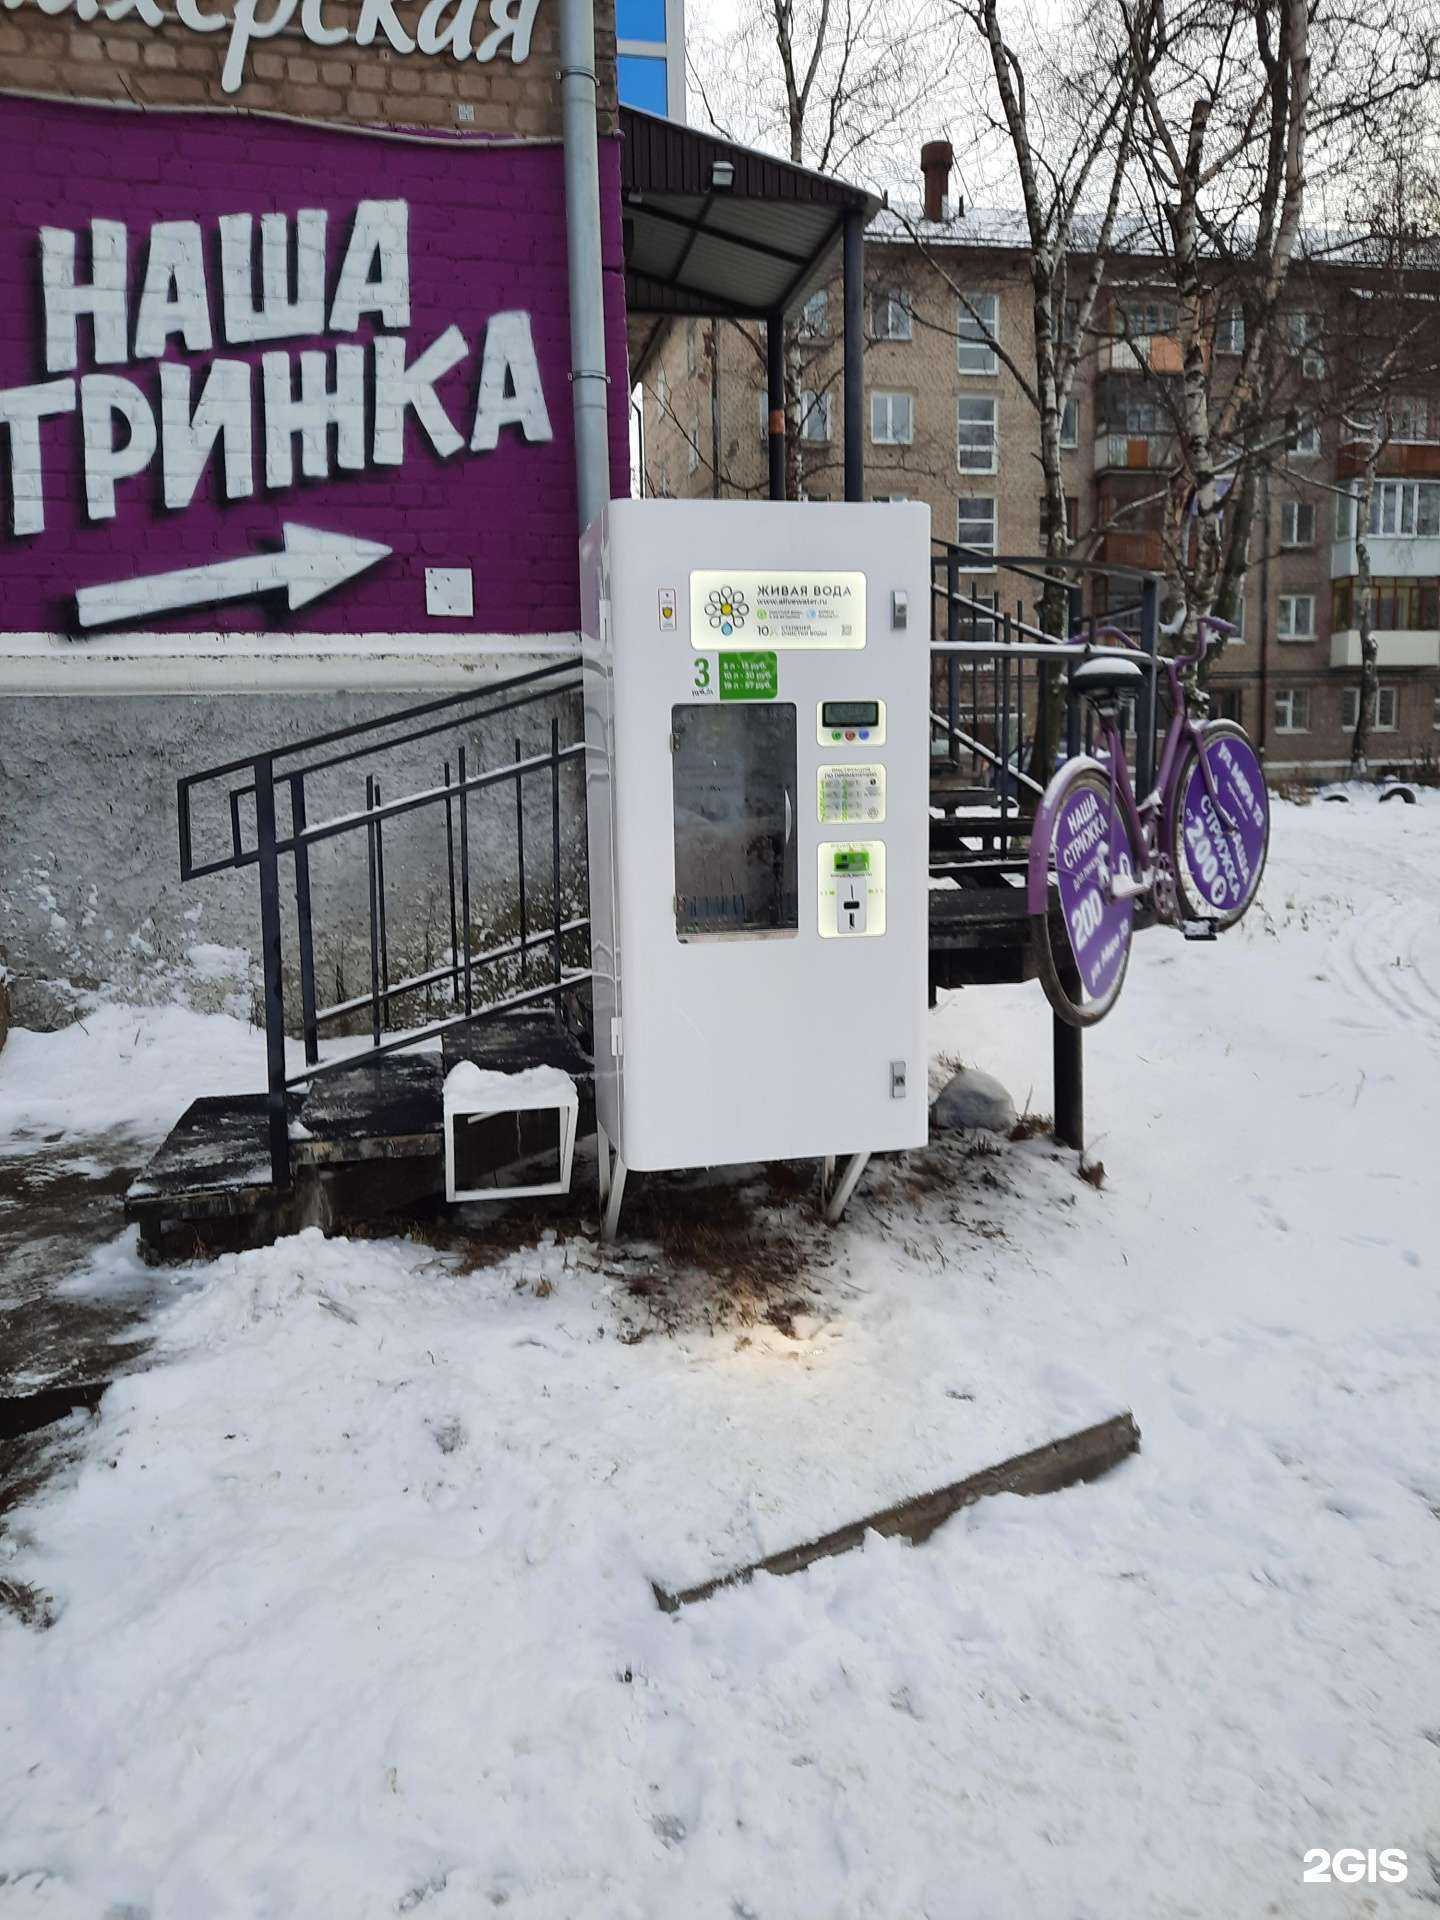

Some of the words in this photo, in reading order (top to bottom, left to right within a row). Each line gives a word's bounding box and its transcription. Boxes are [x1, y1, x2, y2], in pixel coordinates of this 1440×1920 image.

[39, 198, 411, 374] НАША
[0, 309, 554, 536] ТРИЖКА
[757, 585, 808, 596] ЖИВАЯ
[813, 585, 852, 598] ВОДА
[757, 625, 770, 636] 10
[694, 657, 710, 688] 3
[1067, 793, 1099, 836] НАША
[1063, 813, 1109, 869] СТРИЖКА
[1071, 888, 1104, 953] 200
